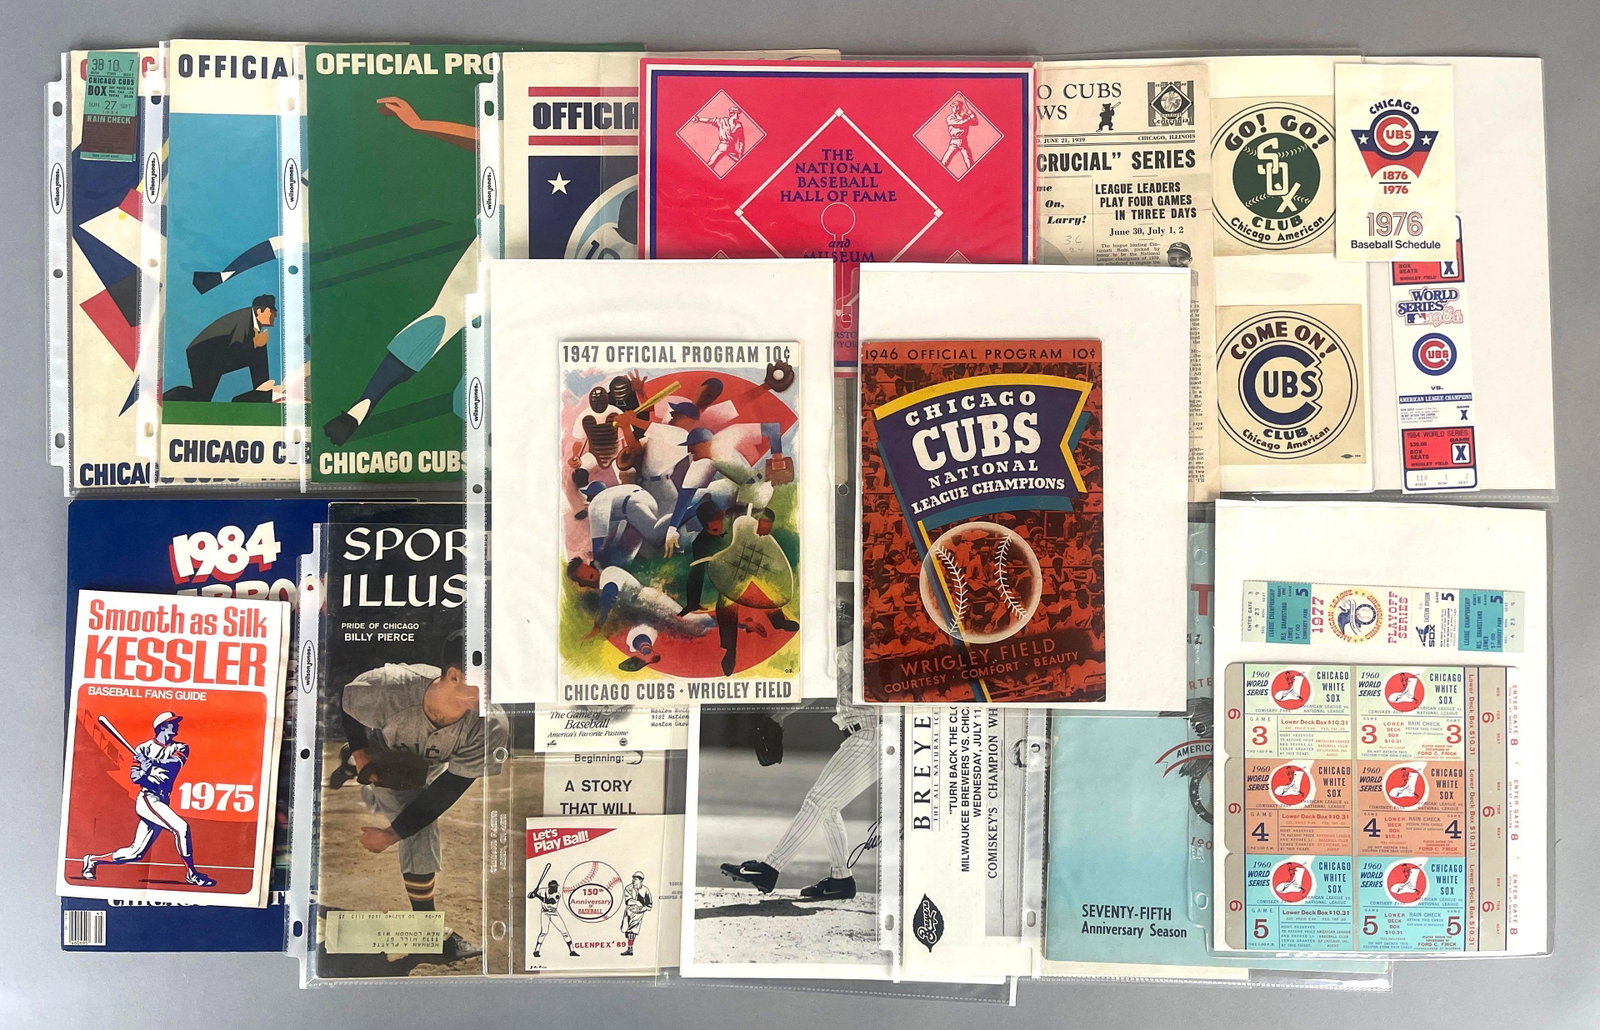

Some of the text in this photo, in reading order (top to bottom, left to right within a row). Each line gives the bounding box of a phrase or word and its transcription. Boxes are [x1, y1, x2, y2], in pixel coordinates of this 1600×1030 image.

[92, 58, 134, 72] 38 10 7
[315, 52, 439, 75] OFFICIAL
[88, 77, 134, 86] CHICAGO CUBS
[88, 85, 107, 96] BOX
[1062, 82, 1122, 99] CUBS
[104, 100, 117, 110] 27
[1369, 98, 1420, 116] CHICAGO
[87, 114, 131, 124] RAIN CHECK
[1224, 113, 1330, 151] GO! GO!
[1376, 116, 1412, 153] CUBS
[822, 149, 854, 162] THE
[1132, 149, 1196, 170] SERIES
[795, 162, 882, 174] NATIONAL
[1257, 137, 1301, 212] SOX
[1382, 170, 1408, 180] 1876
[797, 176, 879, 188] BASEBALL
[1095, 182, 1180, 195] LEAGUE LEADERS
[780, 190, 898, 202] HALL OF FAME
[1383, 185, 1409, 194] 1976
[1045, 200, 1064, 208] On,
[1100, 194, 1192, 208] PLAY FOUR GAMES
[1047, 215, 1087, 226] Larry!
[1115, 207, 1197, 220] IN THREE DAYS
[1231, 216, 1324, 242] Chicago American
[1252, 215, 1304, 231] CLUB
[1366, 211, 1423, 237] 1976
[1110, 226, 1184, 236] June 30, July 1, 2
[828, 238, 850, 249] and
[1350, 239, 1441, 250] Baseball Schedule
[802, 251, 876, 264] MUSEUM
[1411, 288, 1458, 302] WORLD
[1398, 300, 1444, 314] SERIES
[1231, 321, 1337, 360] COME ON!
[563, 345, 792, 364] 1947 OFFICIAL PROGRAM 10¢
[864, 348, 1096, 362] 1946 OFFICIAL PROGRAM 10¢
[1242, 344, 1318, 426] CUBS
[1399, 396, 1423, 404] AMERICAN
[1424, 395, 1444, 403] LEAGUE
[905, 390, 1037, 426] CHICAGO
[1242, 426, 1330, 450] Chicago American
[1262, 427, 1309, 440] CLUB
[911, 411, 1042, 472] CUBS
[168, 438, 264, 465] CHICAGO
[320, 450, 412, 476] CHICAGO
[928, 460, 1039, 490] NATIONAL
[910, 477, 1066, 515] LEAGUE CHAMPIONS
[88, 599, 268, 638] Smooth as Silk
[1312, 596, 1324, 634] 1977
[1388, 591, 1397, 644] PLAYOFF
[1398, 596, 1408, 640] SERIES
[342, 622, 420, 630] PRIDE OF CHICAGO
[344, 633, 415, 642] BILLY PIERCE
[84, 634, 268, 687] KESSLER
[900, 637, 1056, 678] WRIGLEY FIELD
[884, 651, 1080, 694] COURTESY COMFORT BEAUTY
[1251, 670, 1270, 678] 1960
[1316, 672, 1349, 680] CHICAGO
[88, 686, 207, 701] BASEBALL FANS GUIDE
[564, 681, 792, 701] CHICAGO CUBS WRIGLEY FIELD
[1246, 688, 1268, 696] SERIES
[1322, 683, 1344, 692] WHITE
[1326, 694, 1341, 702] SOX
[550, 711, 565, 719] The
[566, 711, 592, 719] Game
[564, 718, 610, 730] Baseball
[604, 730, 629, 738] Pastime
[1252, 726, 1268, 746] 3
[961, 736, 970, 752] VS.
[574, 754, 625, 764] Beginning:
[949, 727, 958, 815] "TURN BACK THE
[973, 721, 983, 818] WEDNESDAY, JULY
[988, 734, 998, 800] CHAMPION
[564, 780, 632, 792] A STORY
[961, 754, 970, 808] BREWERS
[178, 782, 255, 813] 1975
[560, 802, 636, 815] THAT WILL
[532, 828, 558, 842] Let's
[1252, 822, 1269, 842] 4
[534, 830, 590, 854] Play Ball!
[961, 810, 970, 872] MILWAUKEE
[988, 806, 998, 879] COMISKEY'S
[1363, 862, 1382, 870] 1960
[1431, 864, 1463, 873] CHICAGO
[1436, 876, 1458, 885] WHITE
[1440, 886, 1454, 896] SOX
[570, 898, 612, 906] Anniversary
[1082, 904, 1172, 921] SEVENTY-FIFTH
[916, 900, 938, 944] Breyers
[1362, 916, 1378, 936] 5
[1082, 921, 1188, 940] Anniversary Season
